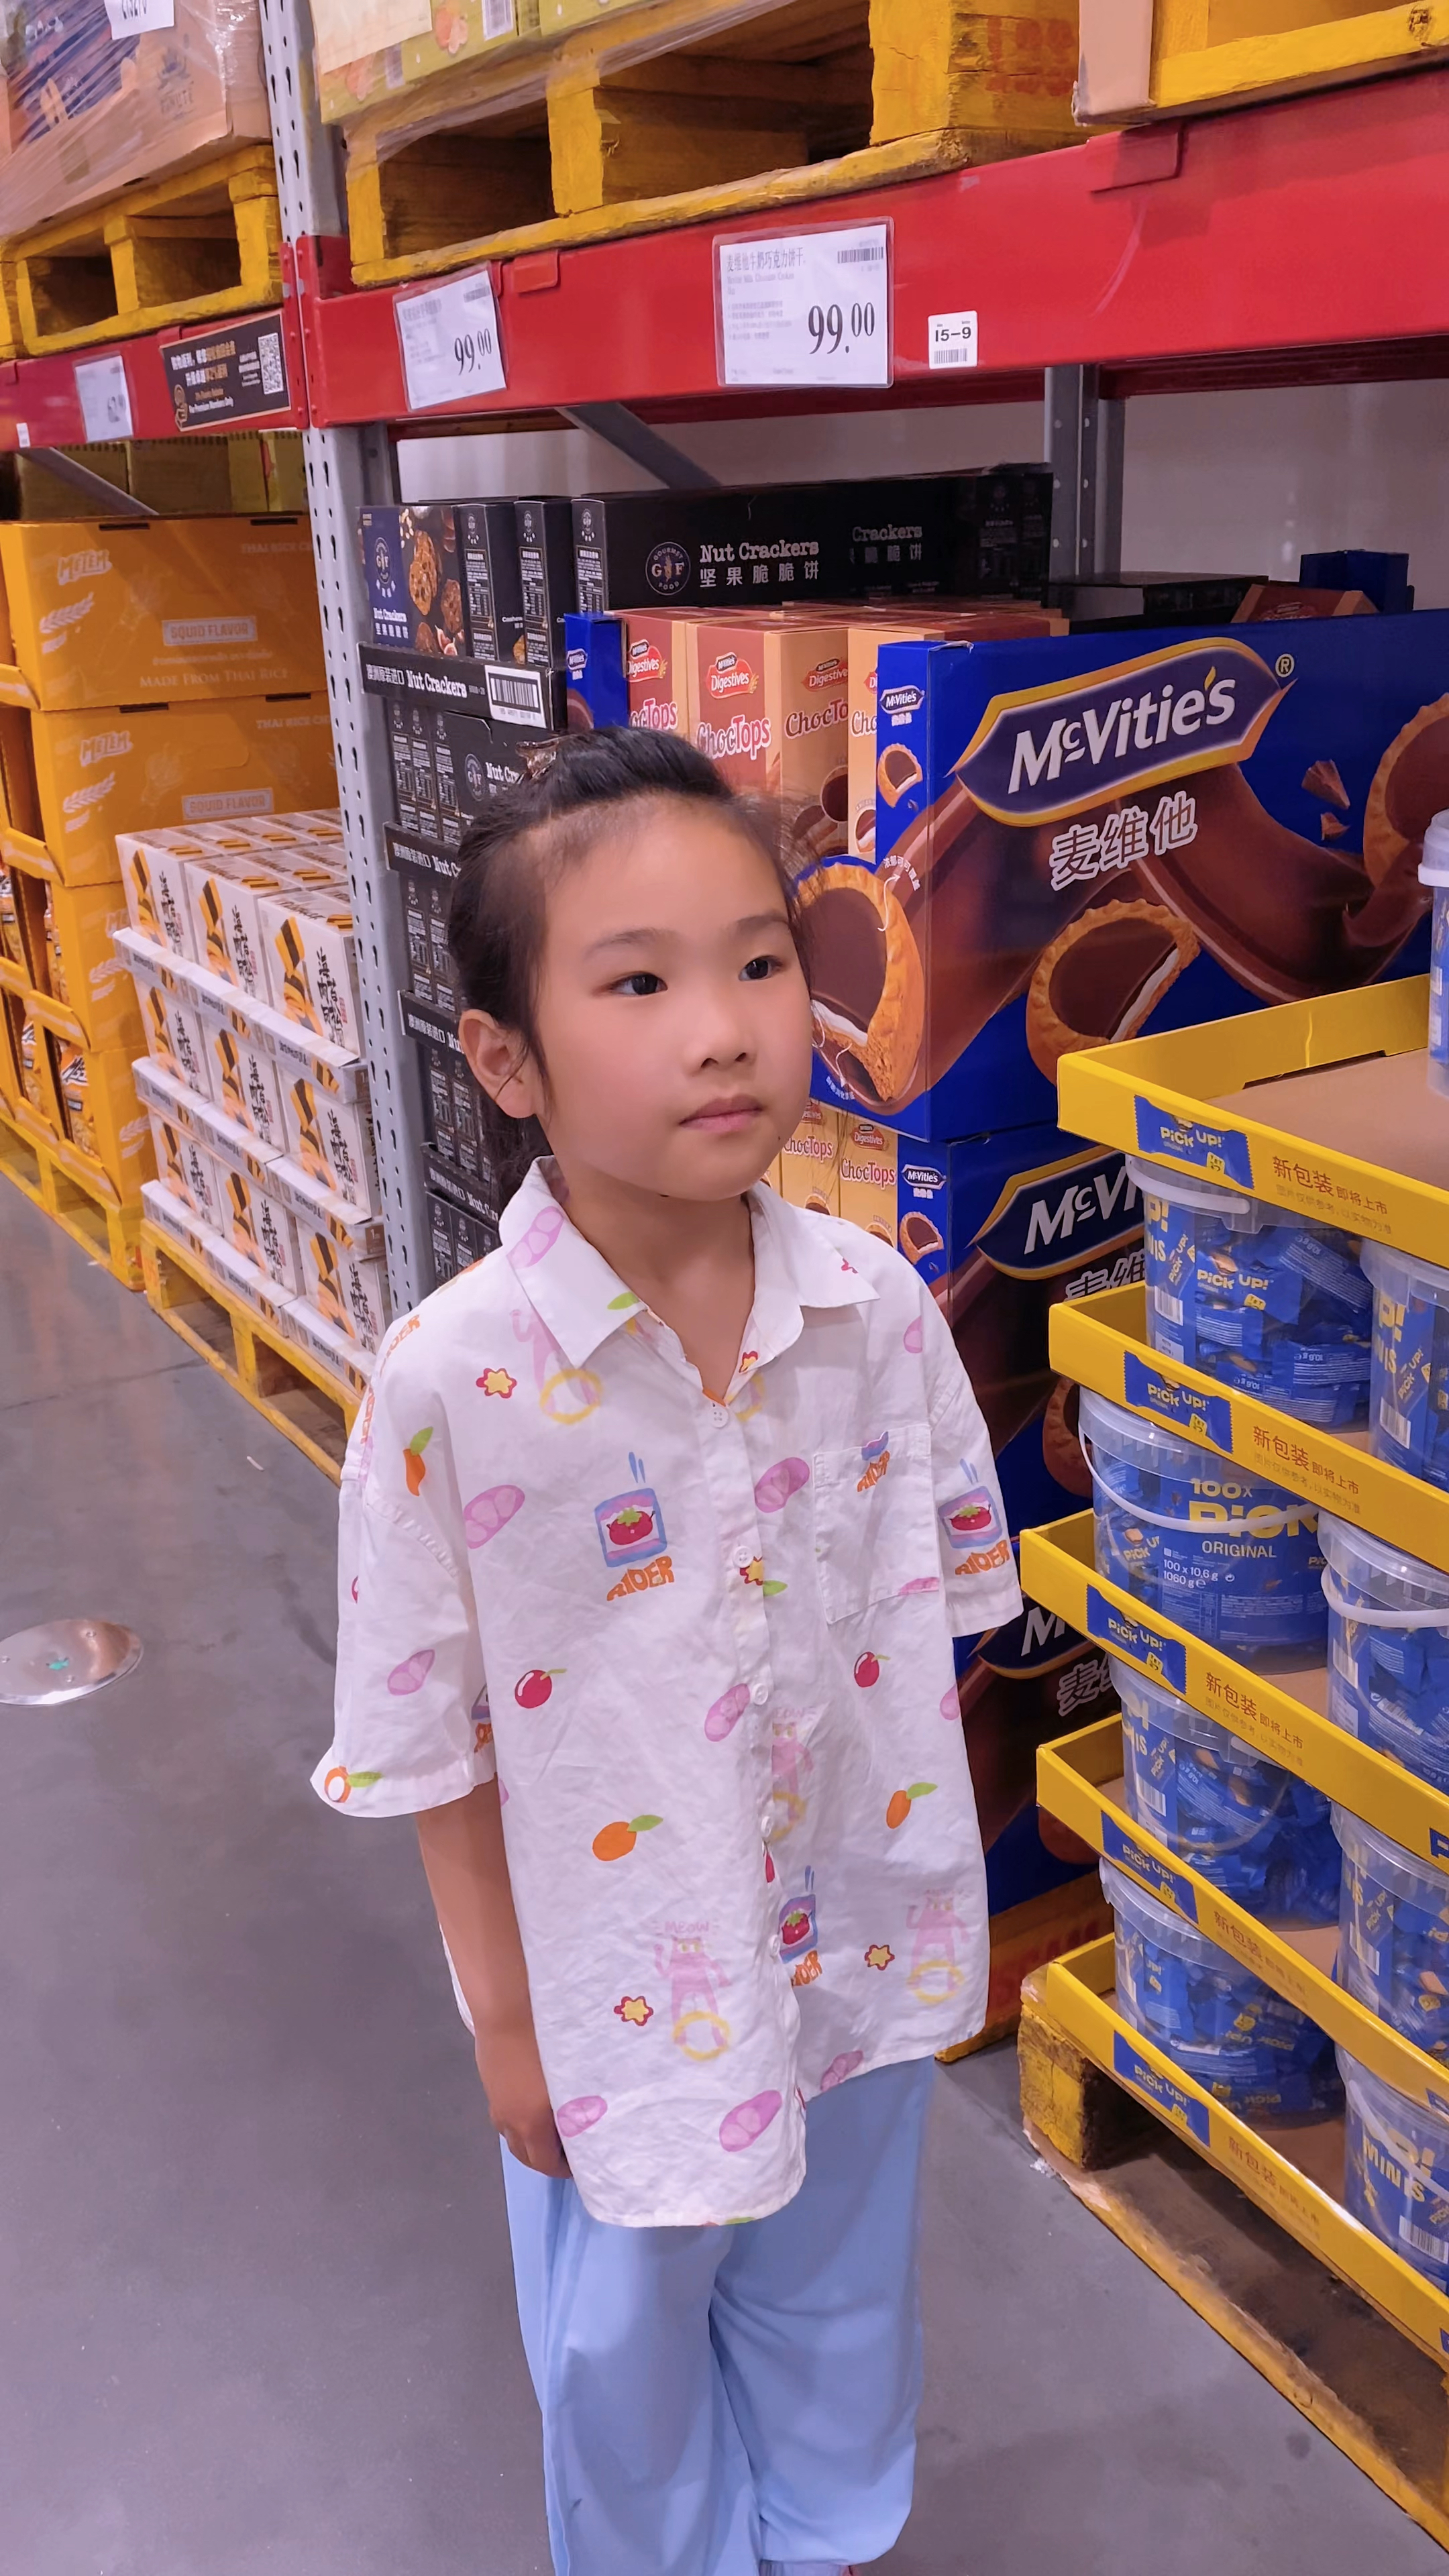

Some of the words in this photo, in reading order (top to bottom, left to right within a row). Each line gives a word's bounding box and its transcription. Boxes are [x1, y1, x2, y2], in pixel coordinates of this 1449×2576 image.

[808, 302, 875, 355] 99.00
[454, 328, 492, 376] 99.00
[852, 524, 922, 542] Crackers
[700, 543, 735, 564] Nut
[739, 540, 820, 559] Crackers
[651, 564, 662, 578] G
[675, 562, 686, 576] F
[700, 560, 820, 588] 坚果脆脆饼
[170, 623, 206, 638] SQUID
[208, 621, 249, 637] FLAVOR
[140, 674, 180, 688] MADE
[183, 671, 220, 685] FROM
[225, 669, 254, 683] THAI
[406, 669, 425, 690] Nut
[425, 673, 468, 698] Crackers
[710, 672, 750, 692] Digestives
[809, 668, 848, 688] Digestive
[885, 690, 917, 708] McVitie's
[785, 698, 848, 738] ChocTo
[696, 714, 772, 761] ChocTops
[1008, 666, 1236, 794] McVitie's
[485, 761, 502, 780] Nut
[1049, 791, 1198, 892] 麦维他
[432, 855, 451, 876] Nut
[447, 1031, 465, 1055] Nu
[1195, 1130, 1222, 1148] UP!
[841, 1159, 896, 1191] ChocTops
[908, 1169, 938, 1183] McVitie's
[1238, 1274, 1269, 1290] UP!
[1182, 1391, 1206, 1411] UP!
[1201, 1540, 1277, 1559] ORIGINAL
[1163, 1558, 1181, 1572] 100
[606, 1555, 674, 1601] RIDER
[1163, 1570, 1186, 1585] 1060
[665, 1920, 710, 1934] MEOW
[1363, 2135, 1426, 2202] MINIS
